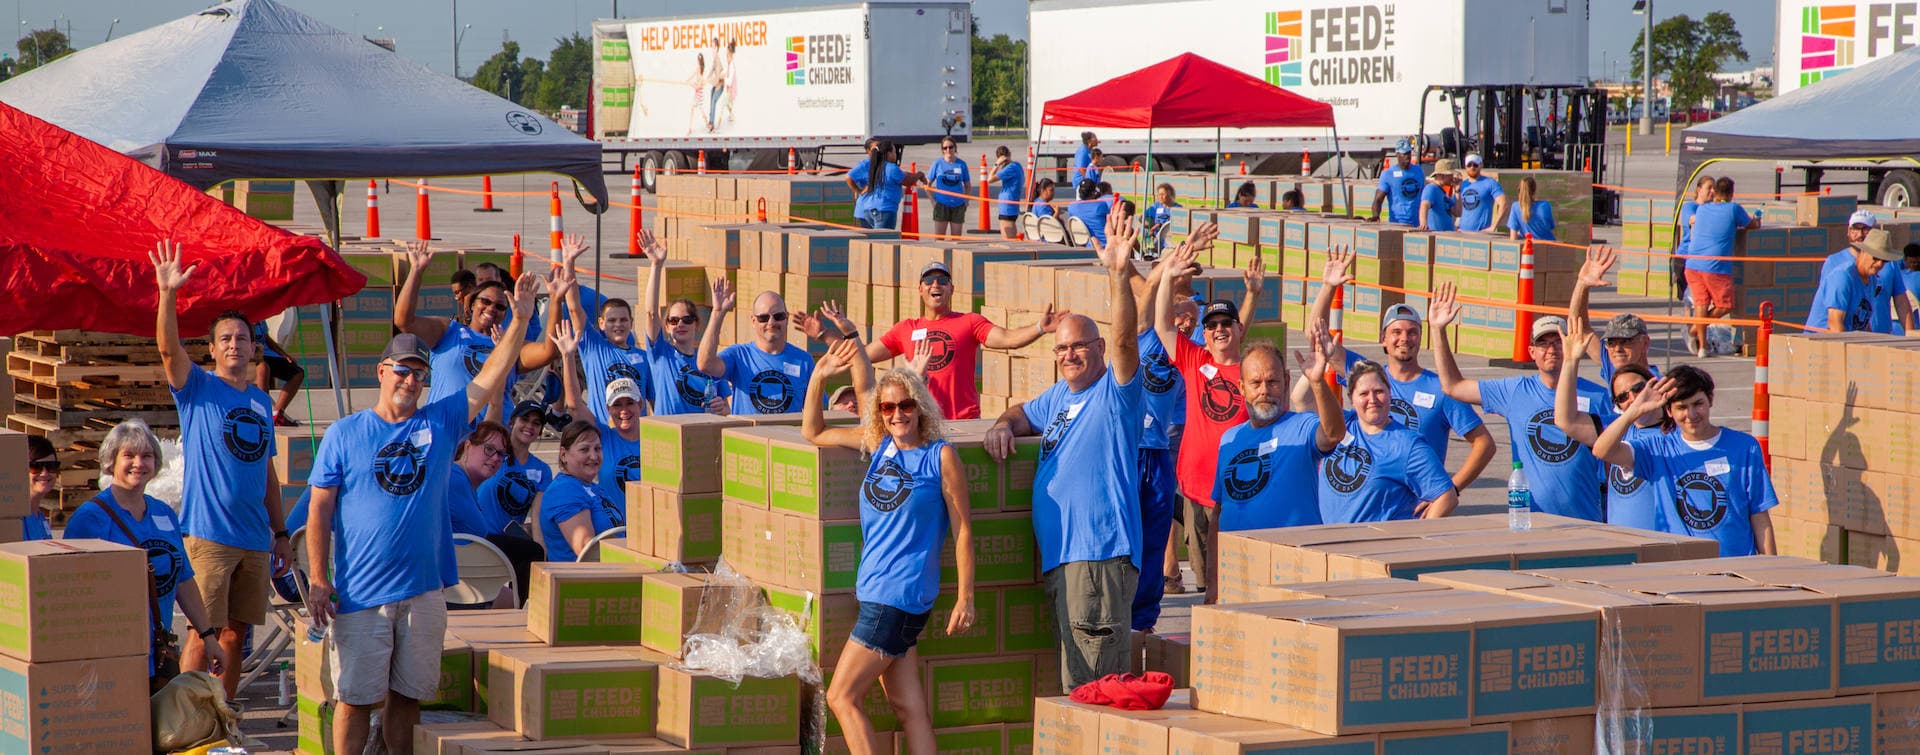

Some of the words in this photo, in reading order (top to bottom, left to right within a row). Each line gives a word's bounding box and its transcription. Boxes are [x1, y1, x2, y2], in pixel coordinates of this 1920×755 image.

[641, 25, 669, 51] HELP
[673, 23, 715, 49] DEFEAT
[717, 20, 768, 47] HUNGER
[1310, 5, 1382, 53] FEED
[1384, 4, 1395, 50] THE
[808, 34, 845, 64] FEED
[1539, 410, 1554, 420] LOV
[1537, 450, 1552, 461] ONE
[1555, 453, 1569, 461] DAY
[1328, 475, 1341, 491] ONE
[1343, 483, 1355, 492] DAY
[1683, 474, 1699, 484] LOVE
[1703, 475, 1718, 487] OKC
[872, 498, 885, 510] ONE
[886, 500, 898, 510] DAY
[1684, 516, 1699, 528] ONE
[1702, 519, 1716, 529] DAY
[595, 597, 641, 614] FEED
[1750, 628, 1809, 654] FEED
[1810, 627, 1820, 652] THE
[1518, 644, 1576, 673] FEED
[1577, 643, 1586, 667] THE
[1389, 655, 1447, 683] FEED
[1450, 653, 1458, 678] THE
[583, 688, 633, 705] FEED
[969, 678, 1015, 697] FEED
[731, 694, 778, 712] FEED
[1652, 737, 1715, 755] FEED
[1789, 728, 1849, 754] FEED
[1850, 726, 1860, 751] THE
